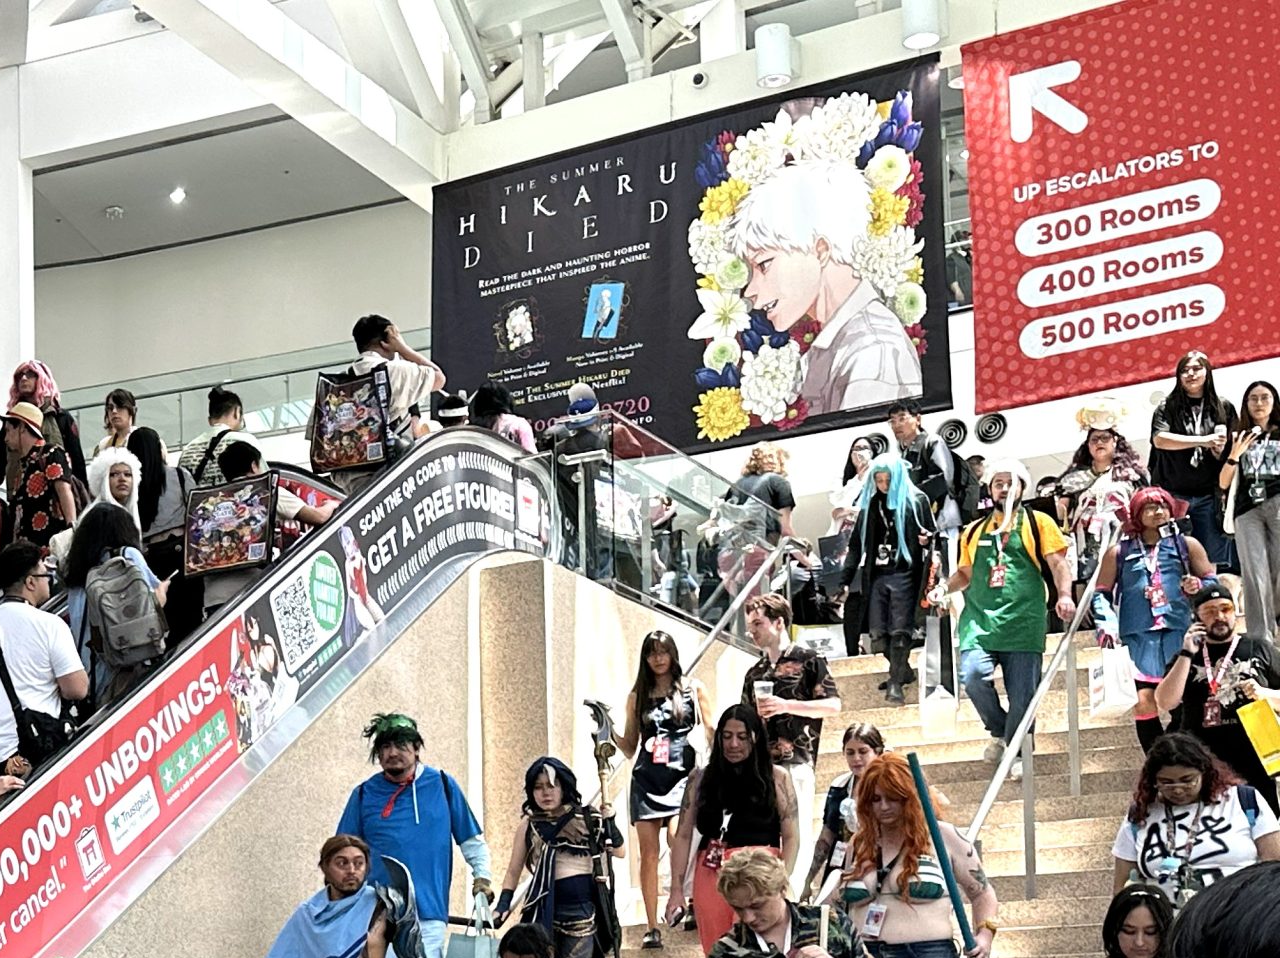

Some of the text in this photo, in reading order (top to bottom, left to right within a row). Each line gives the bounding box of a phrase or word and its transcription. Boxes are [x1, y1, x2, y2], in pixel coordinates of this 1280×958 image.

[459, 162, 678, 236] HIKARU
[504, 157, 625, 196] THE SUMMER
[1013, 141, 1220, 204] UP ESCALATORS TO
[464, 200, 669, 269] DIED
[1036, 193, 1202, 246] 300 Rooms
[480, 279, 534, 297] MASTERPIECE
[535, 273, 557, 285] THAT
[559, 264, 597, 279] INSPIRED
[600, 259, 617, 269] THE
[502, 272, 519, 283] THE
[521, 267, 543, 279] DARK
[544, 262, 564, 273] AND
[566, 250, 612, 267] HAUNTING
[614, 242, 651, 257] HORROR
[1039, 244, 1205, 296] 400 Rooms
[1041, 298, 1206, 349] 500 Rooms
[359, 454, 456, 537] SCAN THE QR CODE TO
[367, 481, 516, 575] GET A FREE FIGURE!
[84, 663, 223, 807] UNBOXINGS!
